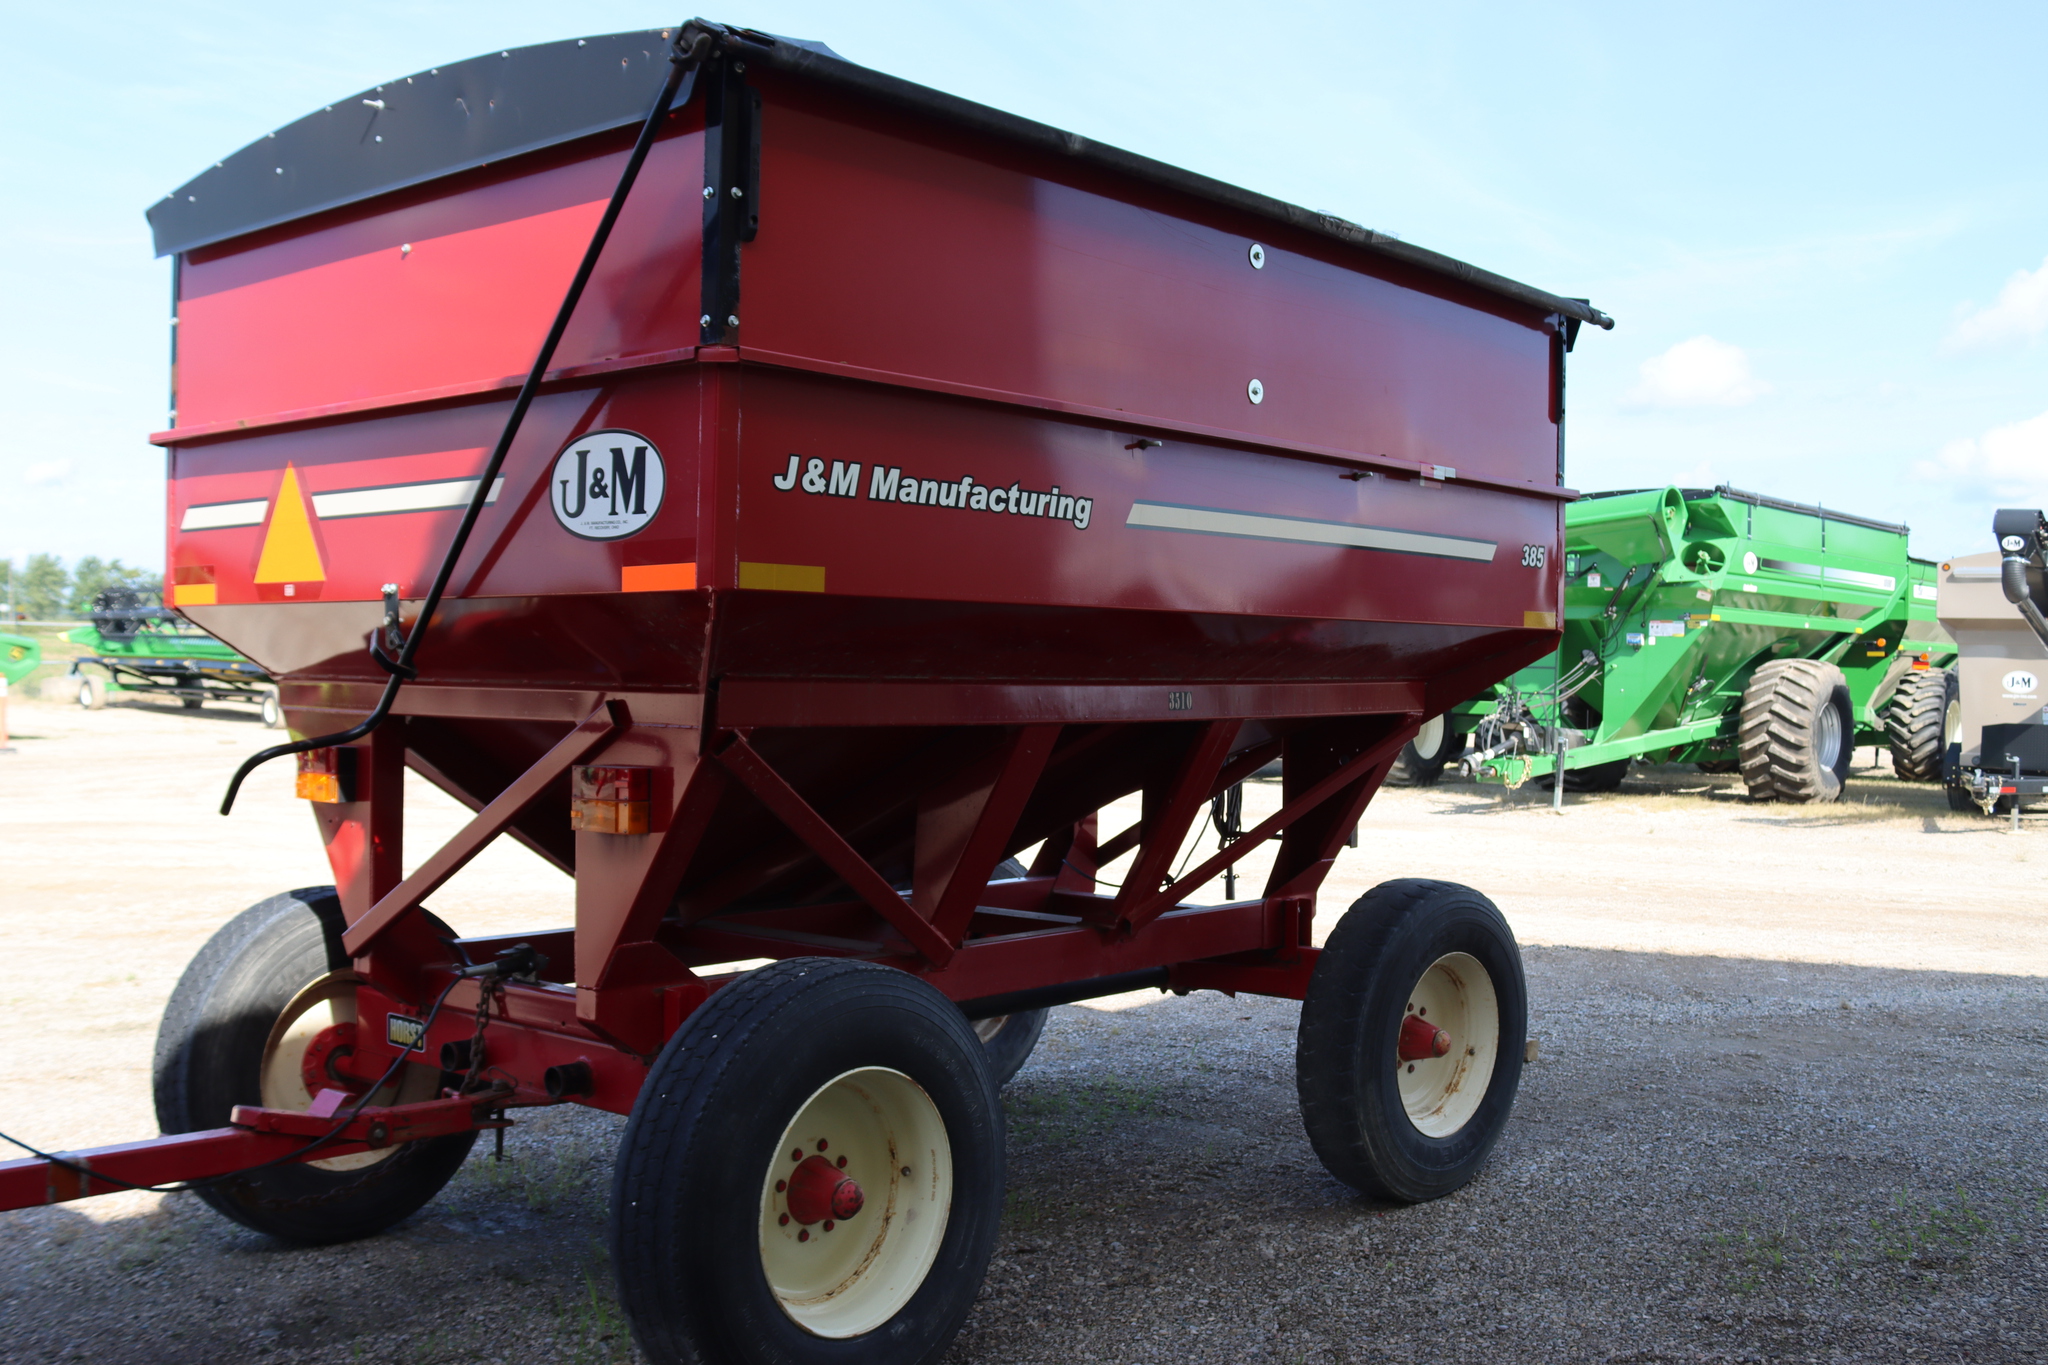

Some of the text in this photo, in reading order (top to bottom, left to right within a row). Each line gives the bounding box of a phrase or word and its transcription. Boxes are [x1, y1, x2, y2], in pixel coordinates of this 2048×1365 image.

[560, 446, 648, 518] J&M
[773, 454, 1093, 530] J&M Manufacturing
[1521, 544, 1545, 569] 385
[1169, 692, 1193, 710] 3510
